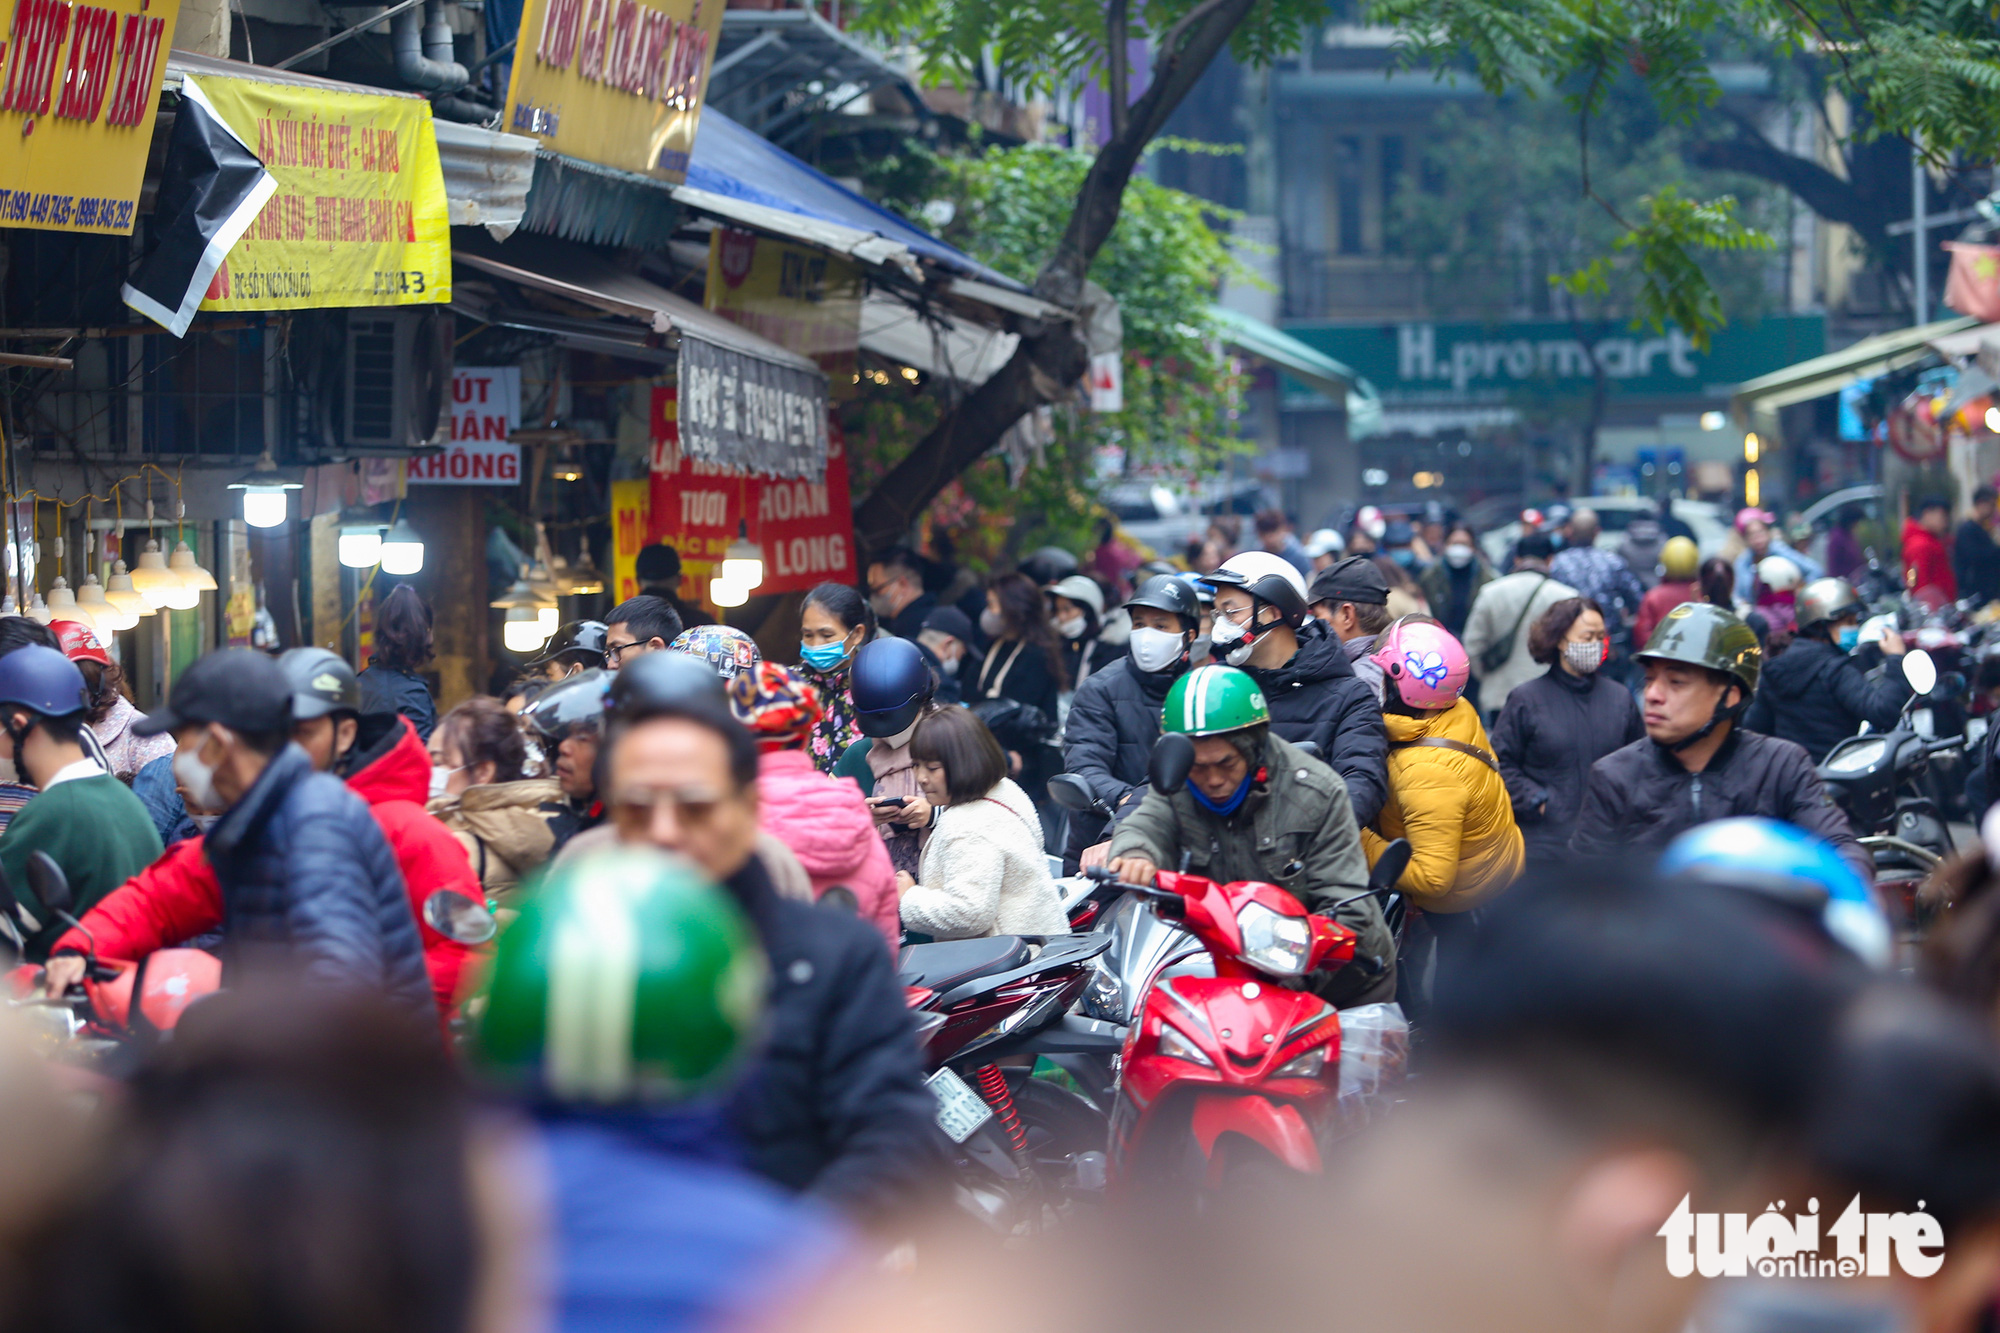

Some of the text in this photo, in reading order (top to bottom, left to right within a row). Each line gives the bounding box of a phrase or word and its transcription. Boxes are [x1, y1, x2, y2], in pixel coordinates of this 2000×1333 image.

[2, 0, 71, 136] THỊT
[55, 4, 117, 123] KHO
[1397, 323, 1698, 393] H.promart
[406, 447, 518, 480] KHÔNG
[775, 533, 847, 576] LONG
